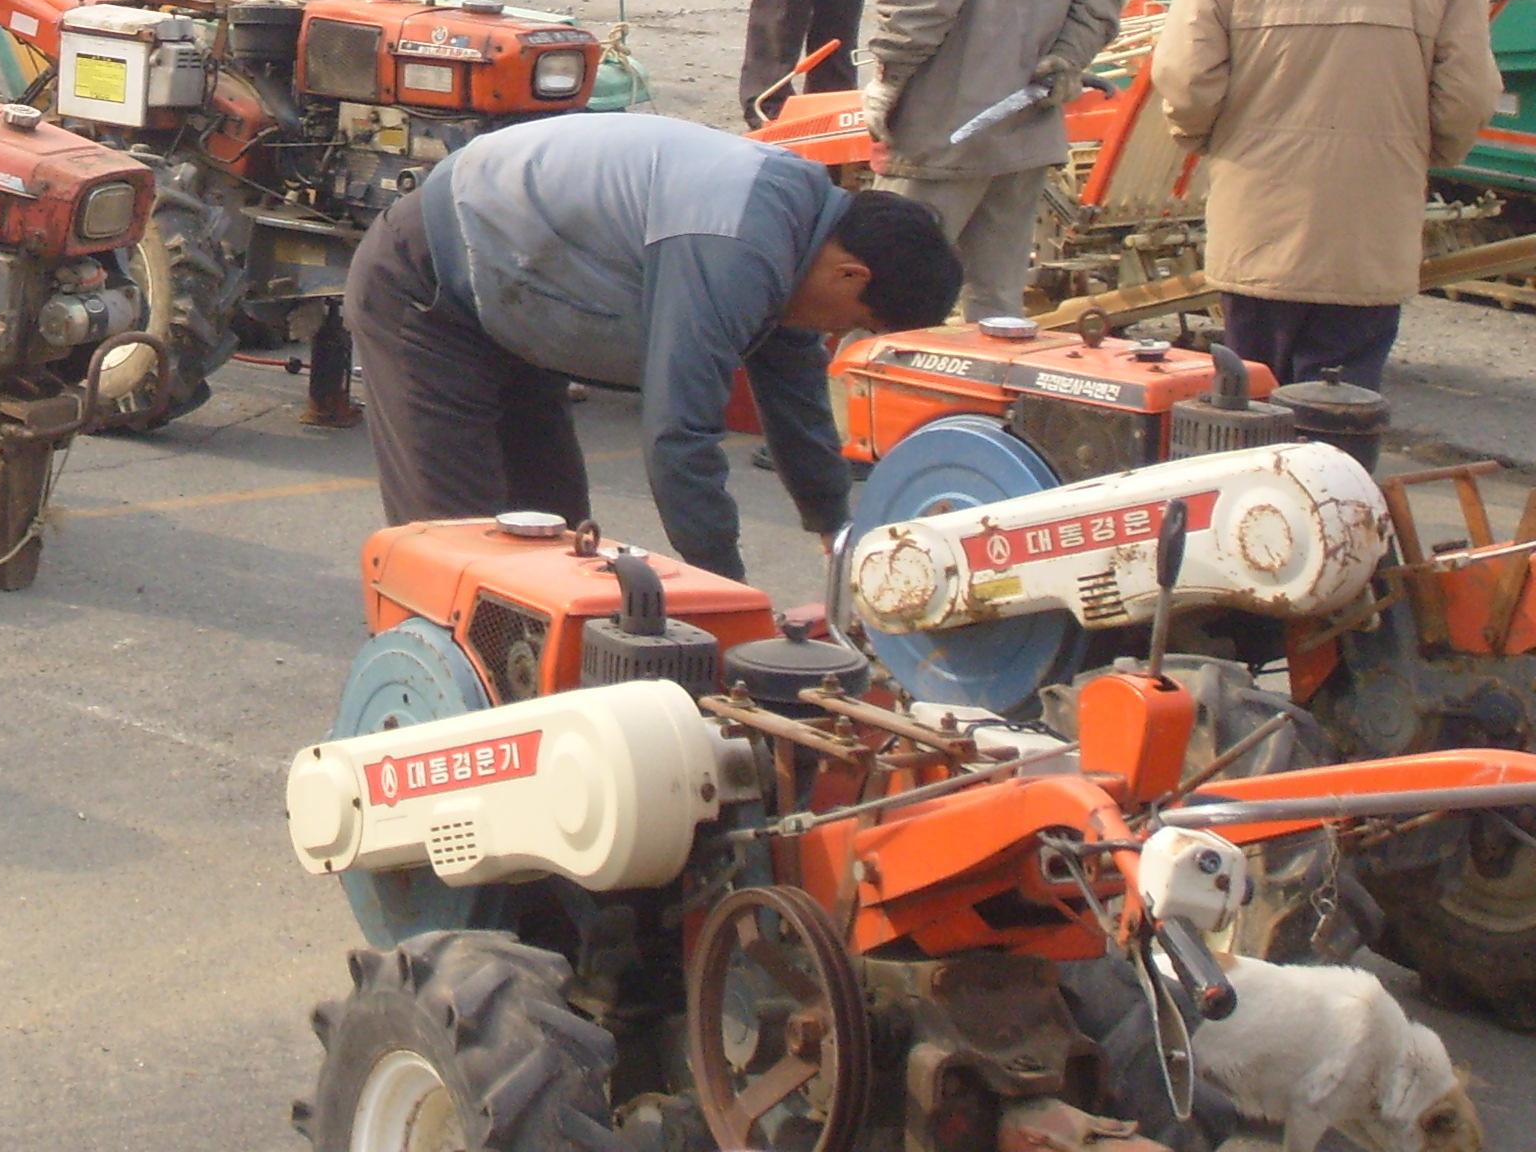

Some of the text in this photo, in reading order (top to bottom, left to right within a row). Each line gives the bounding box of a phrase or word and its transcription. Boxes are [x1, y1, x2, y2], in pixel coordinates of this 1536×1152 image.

[910, 352, 973, 376] ND8DE
[1024, 506, 1167, 556] 대동경운
[406, 741, 521, 789] 대동경운기
